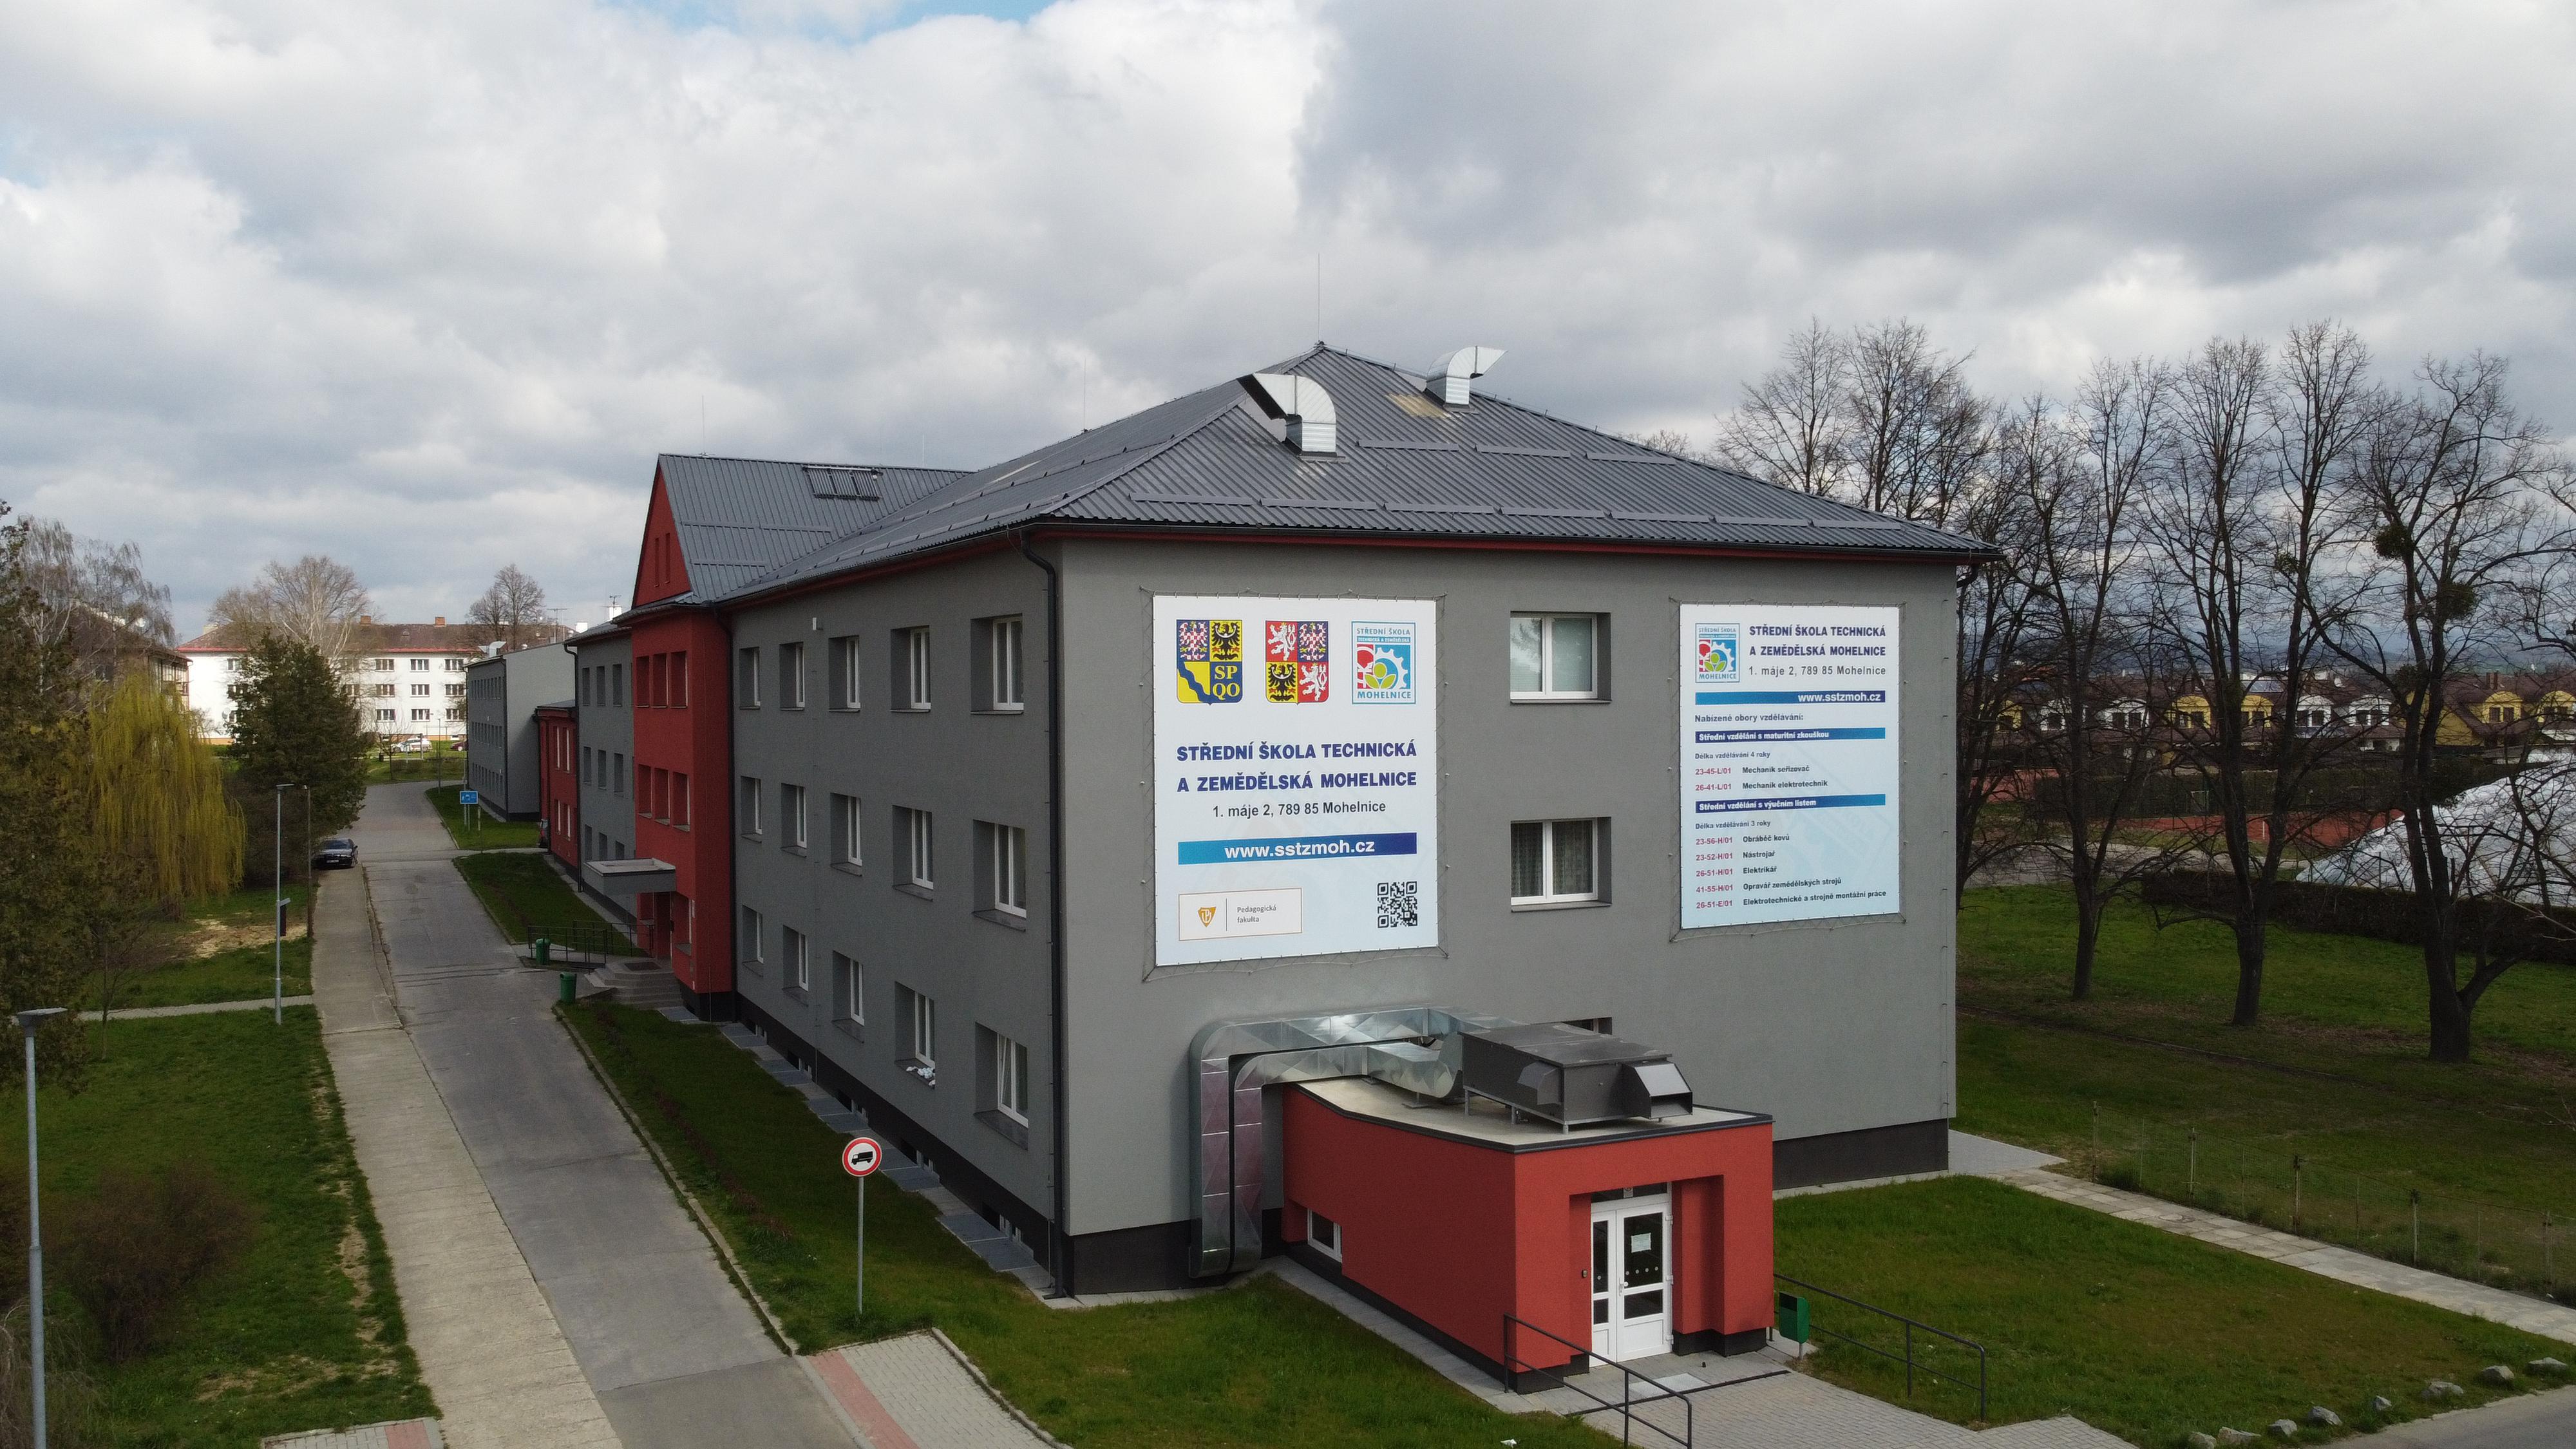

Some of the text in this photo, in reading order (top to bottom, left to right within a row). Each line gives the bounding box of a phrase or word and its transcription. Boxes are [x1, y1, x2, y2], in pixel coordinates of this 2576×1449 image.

[1356, 627, 1386, 635] STŘEDNÍ
[1749, 623, 1792, 636] STŘEDNÍ
[1795, 623, 1828, 636] ŠKOLA
[1830, 625, 1886, 637] TECHNICKÁ
[1750, 644, 1886, 656] A ZEMĚDĚLSKÁ MOHELNICE
[1214, 665, 1238, 679] SP
[1748, 665, 1886, 677] 1. máje 2, 789 85 Mohelnice
[1213, 682, 1240, 700] QO
[1798, 693, 1881, 703] www.sstzmoh.cz
[1735, 714, 1757, 723] obory
[1177, 739, 1417, 761] STŘEDNÍ ŠKOLA TECHNICKÁ
[1177, 771, 1417, 792] A ZEMĚDĚLSKÁ MOHELNICE
[1778, 780, 1828, 788] elektrotechnik
[1213, 801, 1387, 820] 1. máje 2, 789 85 Mohelnice
[1727, 801, 1756, 810] vzdělání
[1795, 799, 1817, 807] listem
[1224, 840, 1375, 858] www.sstzmoh.cz
[1696, 900, 1732, 909] 26-51-E/01
[1743, 895, 1802, 905] Elektrotechnické
[1835, 891, 1866, 899] montážní
[1237, 904, 1277, 914] Pedagogická
